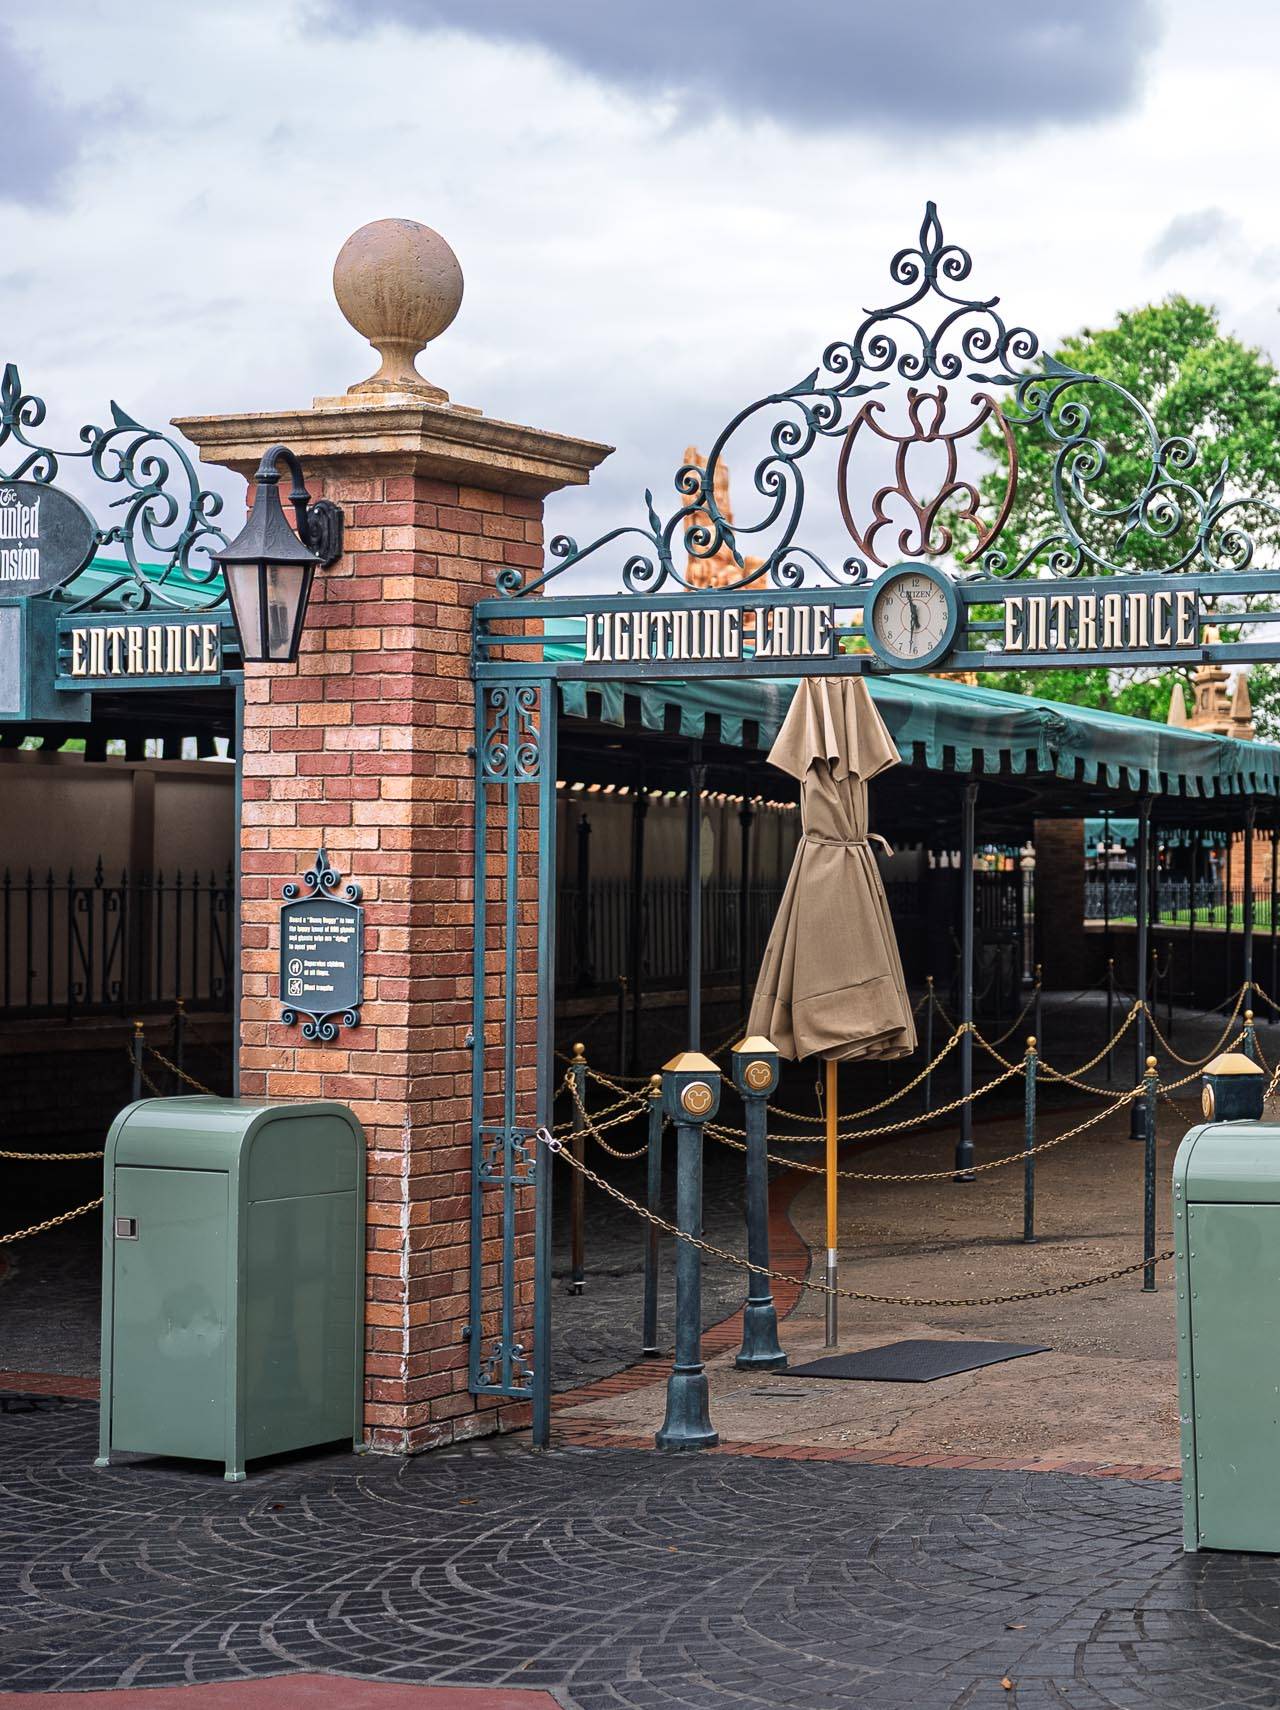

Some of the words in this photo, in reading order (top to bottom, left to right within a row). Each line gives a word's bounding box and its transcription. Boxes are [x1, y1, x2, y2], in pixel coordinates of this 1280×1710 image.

[72, 624, 218, 676] ENTRANCE
[585, 608, 740, 662] LIGHTNING
[754, 606, 831, 656] LANE
[1004, 591, 1195, 650] ENTRANCE
